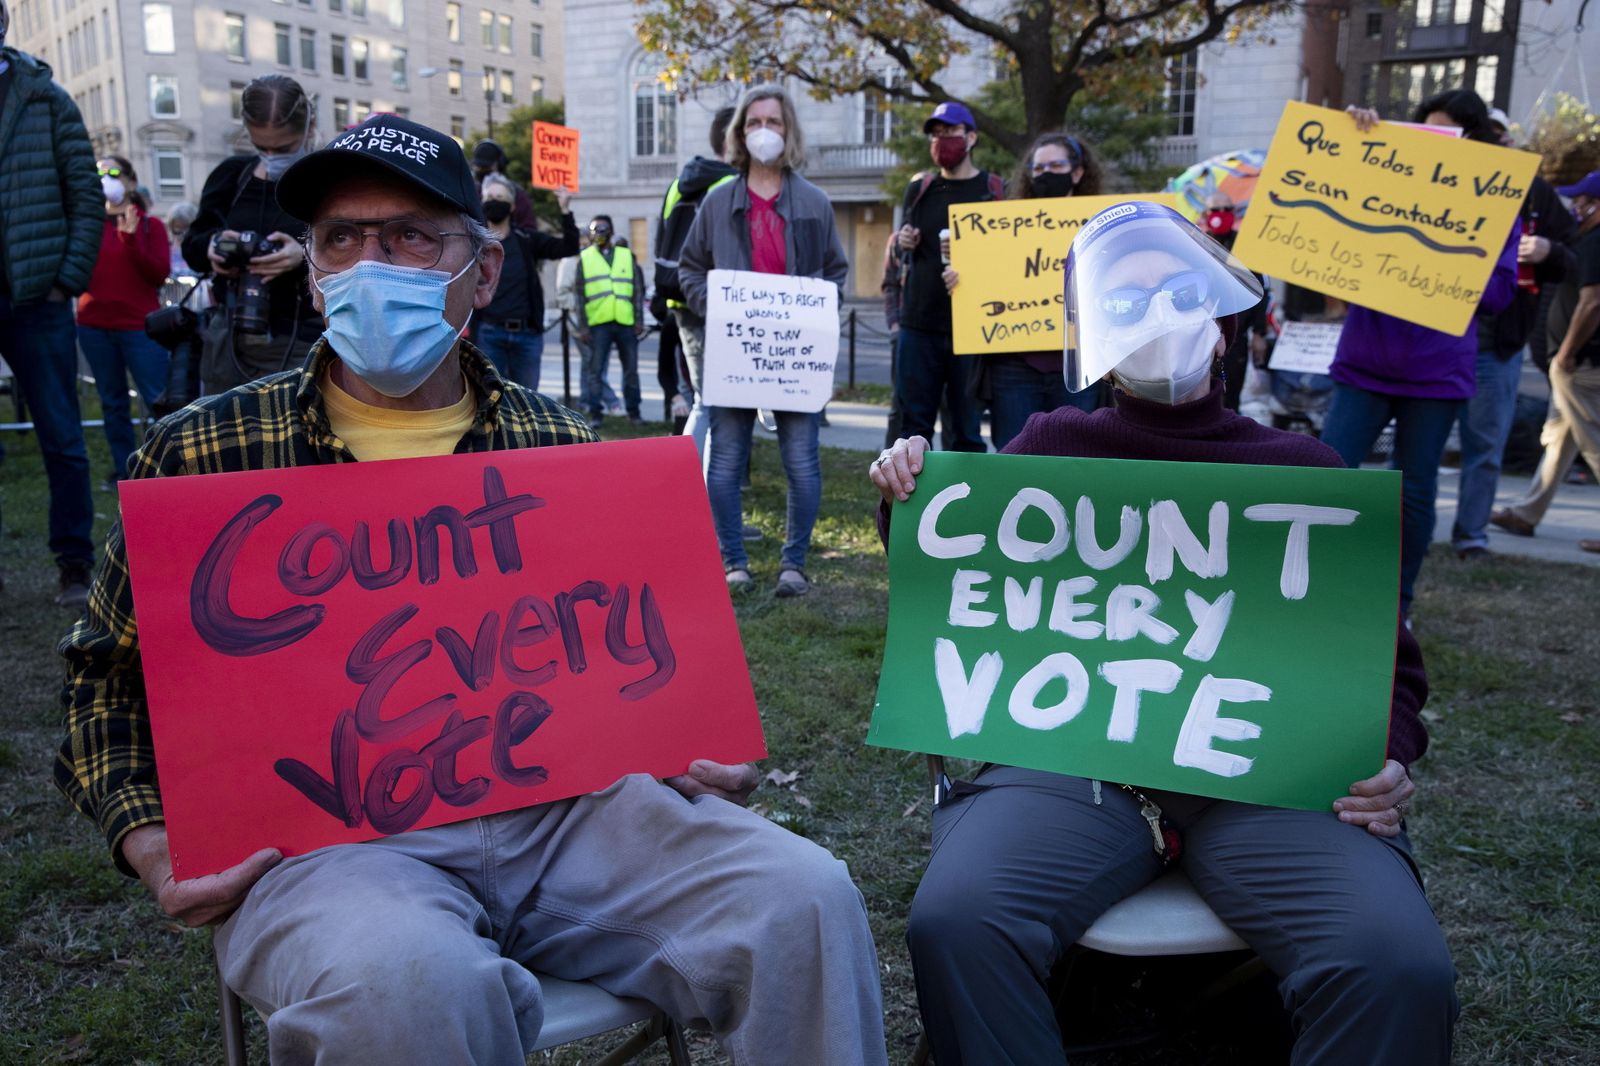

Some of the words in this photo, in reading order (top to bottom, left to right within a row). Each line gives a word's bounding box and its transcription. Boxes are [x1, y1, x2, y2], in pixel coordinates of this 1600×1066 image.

[333, 133, 356, 149] NO
[358, 126, 440, 158] JUSTICE
[367, 138, 427, 165] PEACE
[536, 127, 576, 149] COUNT
[1297, 120, 1341, 156] Que
[1361, 141, 1414, 176] Todos
[1473, 170, 1523, 199] Votos
[536, 164, 575, 189] VOTE
[1096, 205, 1134, 226] Shield
[1280, 170, 1348, 201] Sean
[1361, 195, 1487, 241] Contados!
[1257, 214, 1320, 254] Todos
[1376, 253, 1482, 304] Trabajadores
[1291, 257, 1361, 292] Unidos
[721, 286, 747, 303] THE
[752, 290, 775, 305] WAY
[778, 292, 793, 306] TO
[795, 294, 826, 308] RIGHT
[745, 308, 790, 320] WRONGS
[726, 322, 743, 337] IS
[748, 326, 765, 338] TO
[773, 329, 801, 341] TURN
[981, 318, 1056, 344] Vamos
[741, 341, 763, 354] THE
[769, 345, 795, 356] LIGHT
[801, 345, 814, 355] OF
[752, 357, 785, 371] TRUTH
[792, 361, 805, 371] ON
[917, 481, 1361, 600] COUNT
[190, 465, 546, 657] Count
[947, 568, 1236, 662] EVERY
[345, 579, 677, 743] Every
[934, 637, 1273, 778] VOTE
[274, 690, 554, 836] Vote
